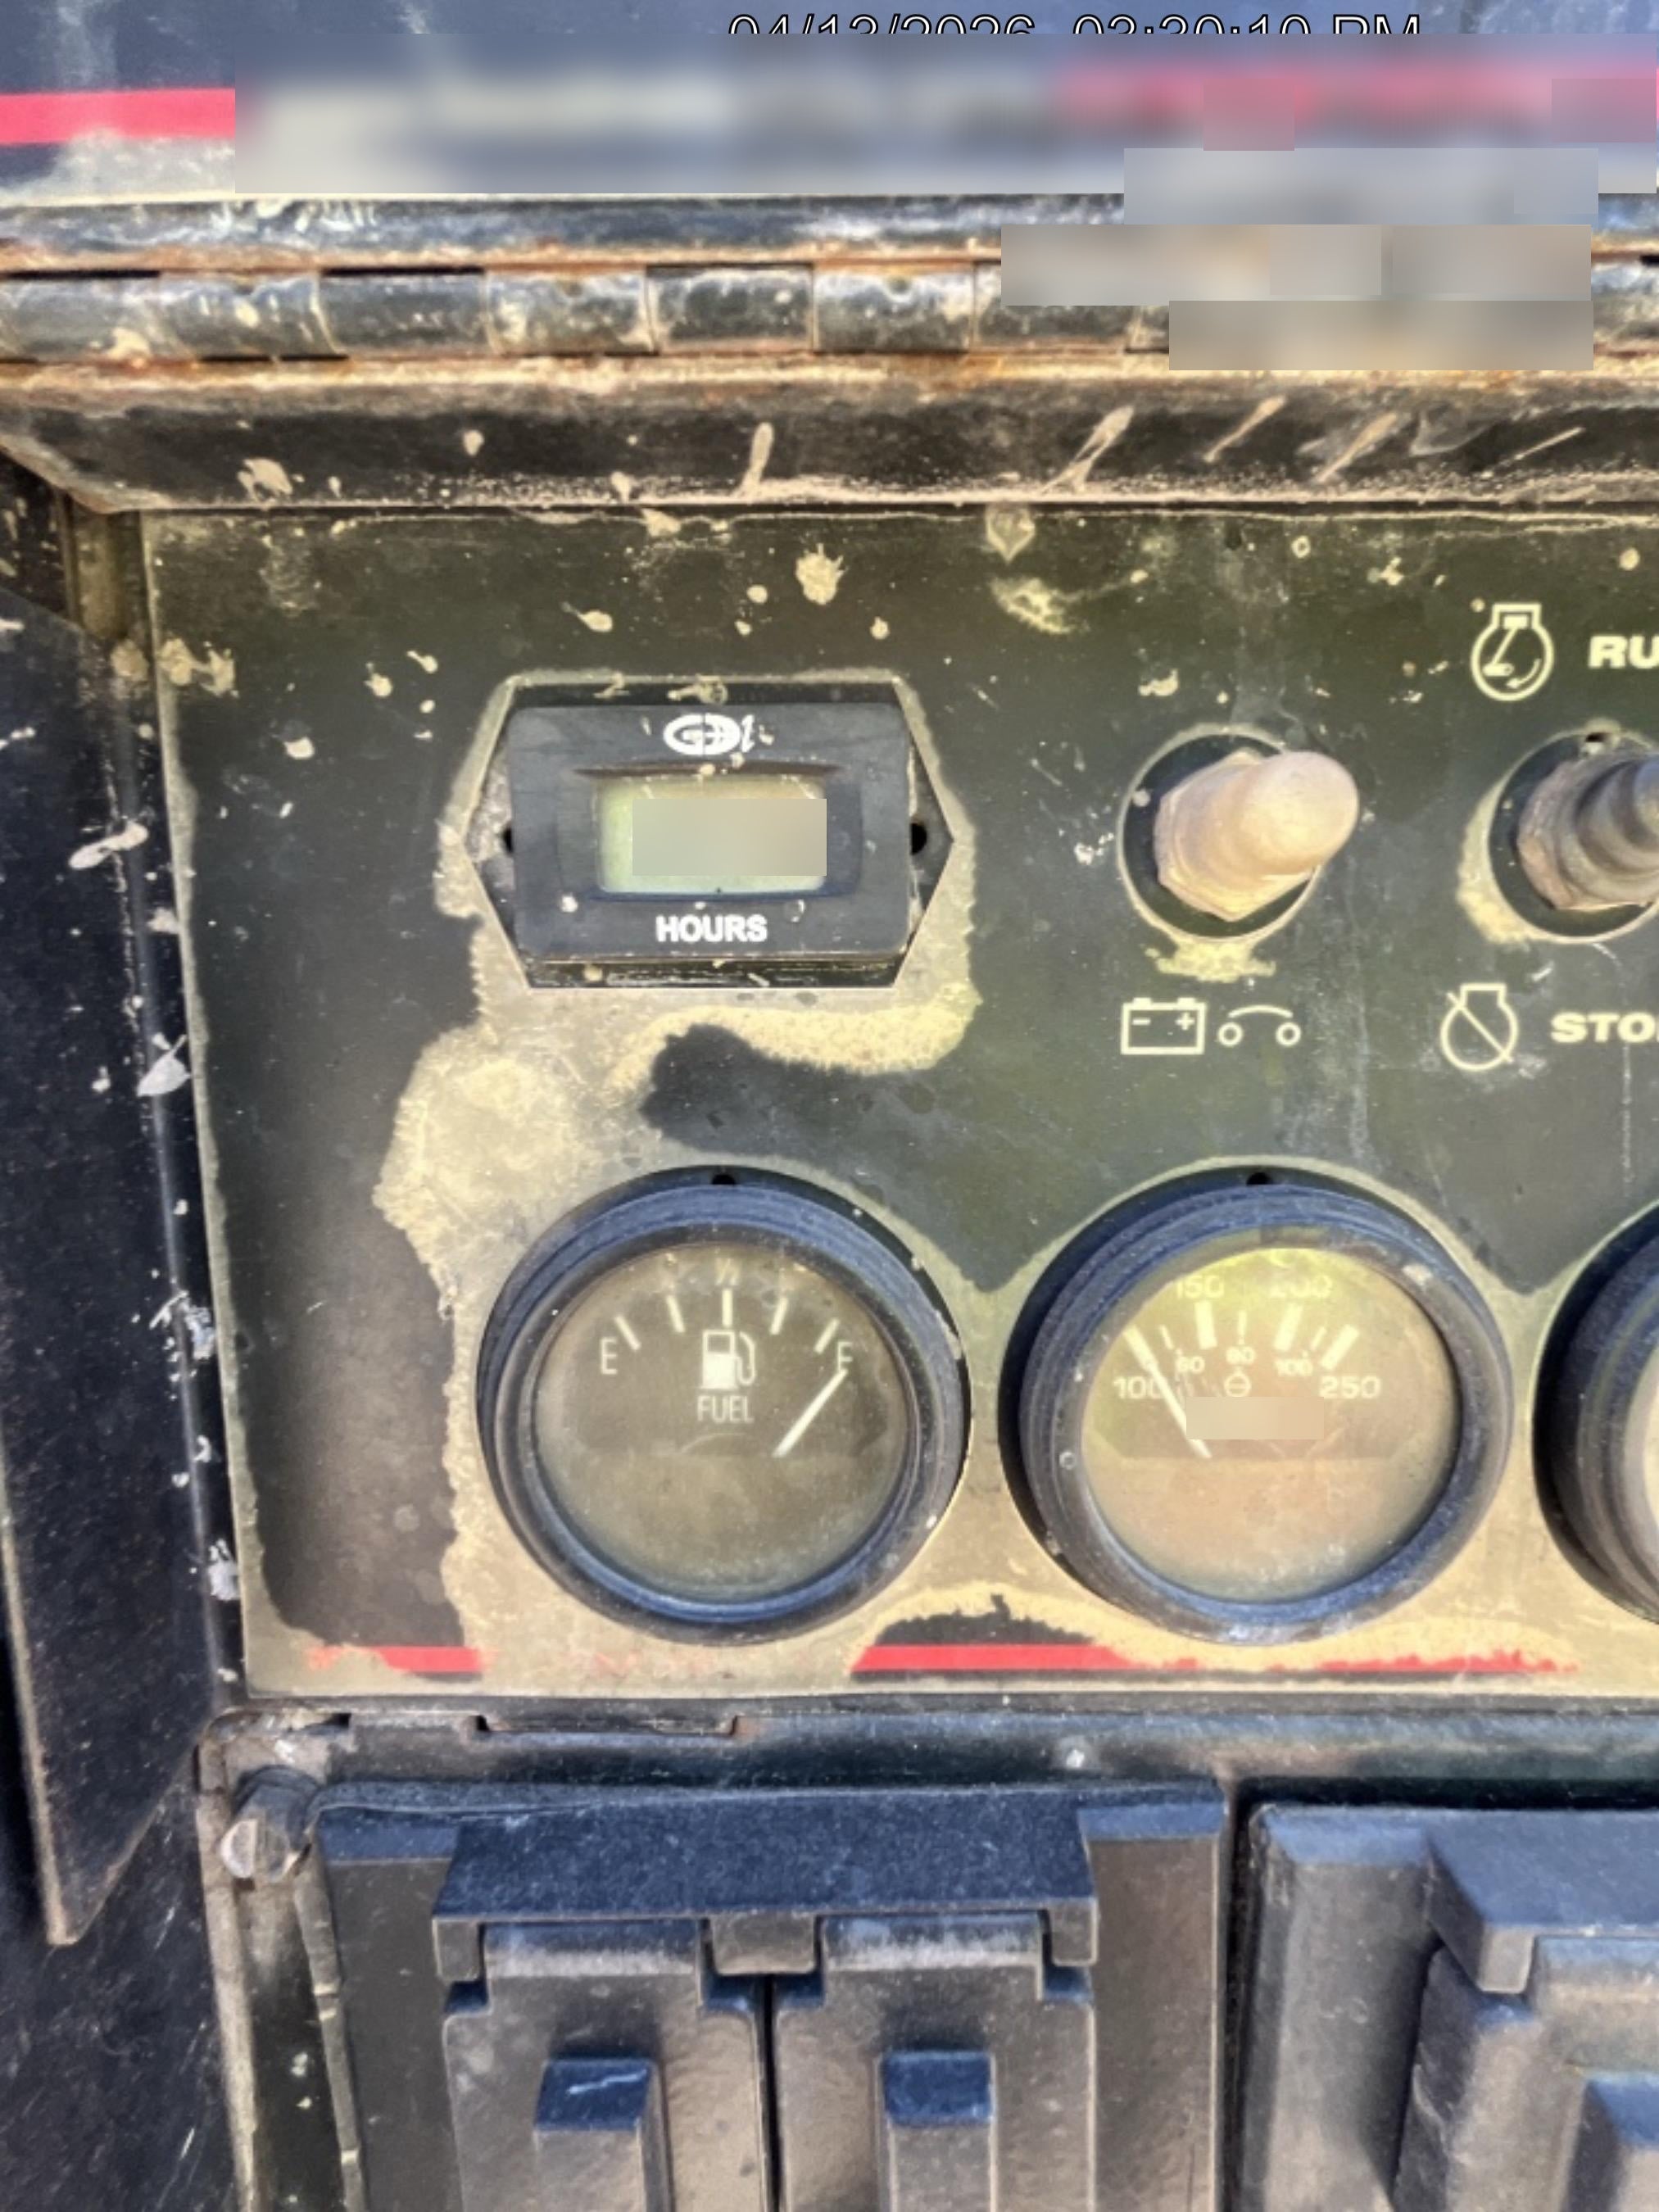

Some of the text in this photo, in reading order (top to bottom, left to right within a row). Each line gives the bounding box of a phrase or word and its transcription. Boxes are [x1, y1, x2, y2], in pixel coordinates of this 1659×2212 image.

[655, 914, 768, 942] HOURS
[1550, 1011, 1659, 1044] STO
[601, 1337, 618, 1375] E
[836, 1341, 854, 1372] F
[1319, 1376, 1382, 1399] 250
[697, 1395, 754, 1424] FUEL
